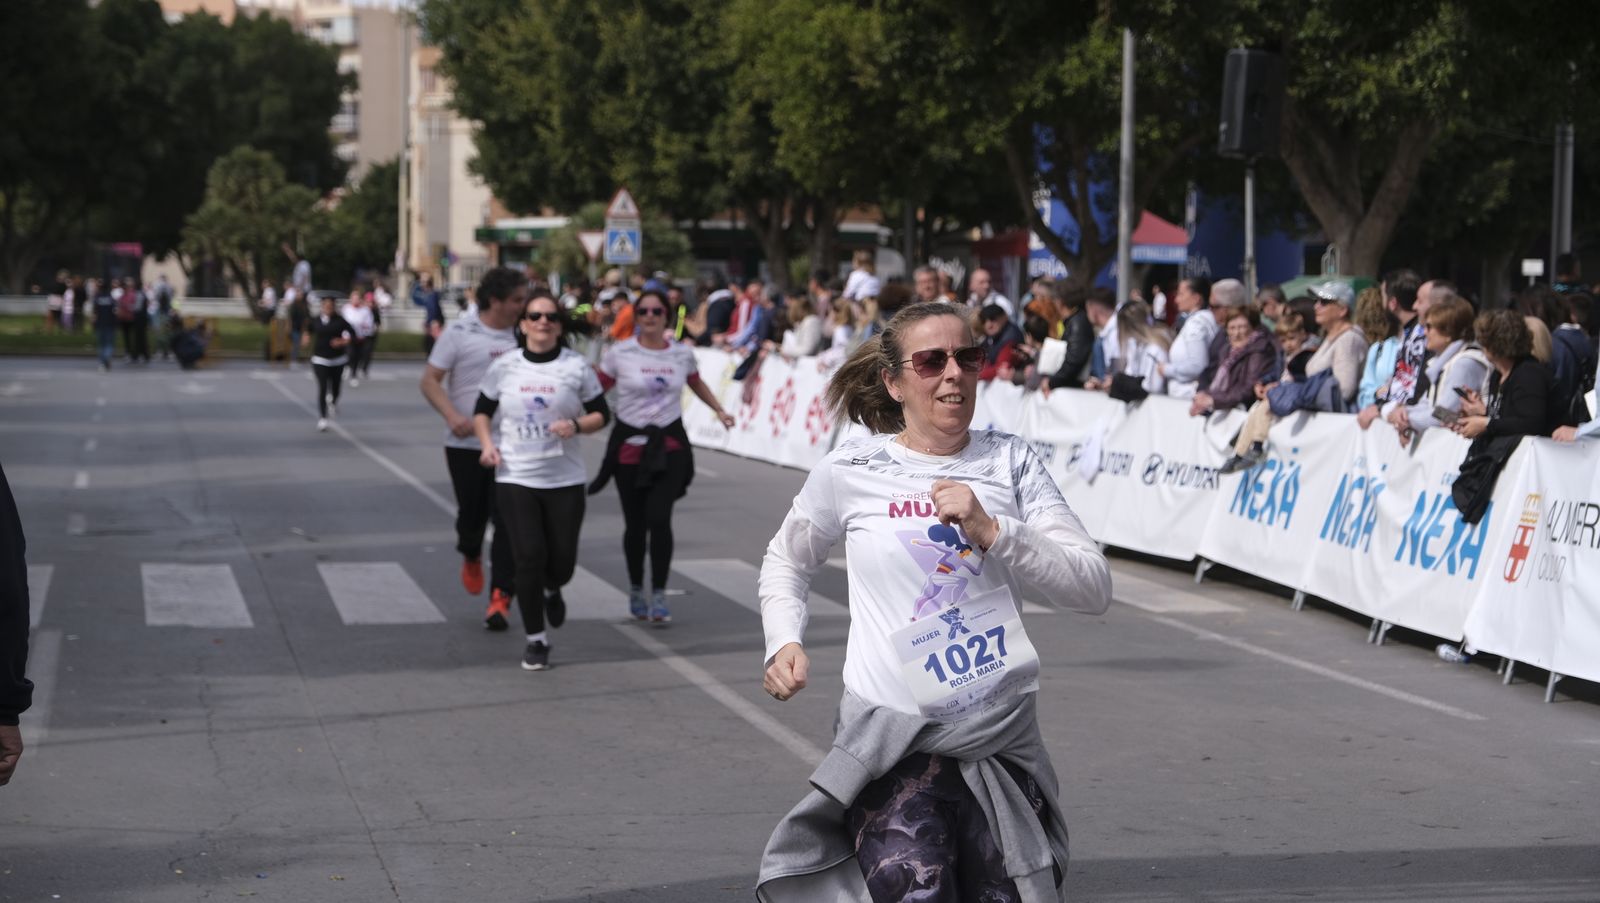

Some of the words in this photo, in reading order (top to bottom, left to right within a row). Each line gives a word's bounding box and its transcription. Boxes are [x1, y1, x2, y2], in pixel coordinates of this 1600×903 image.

[1164, 461, 1221, 490] HYUNDAI
[911, 630, 941, 647] MUJER
[924, 625, 1008, 684] 1027
[949, 670, 976, 688] ROSA
